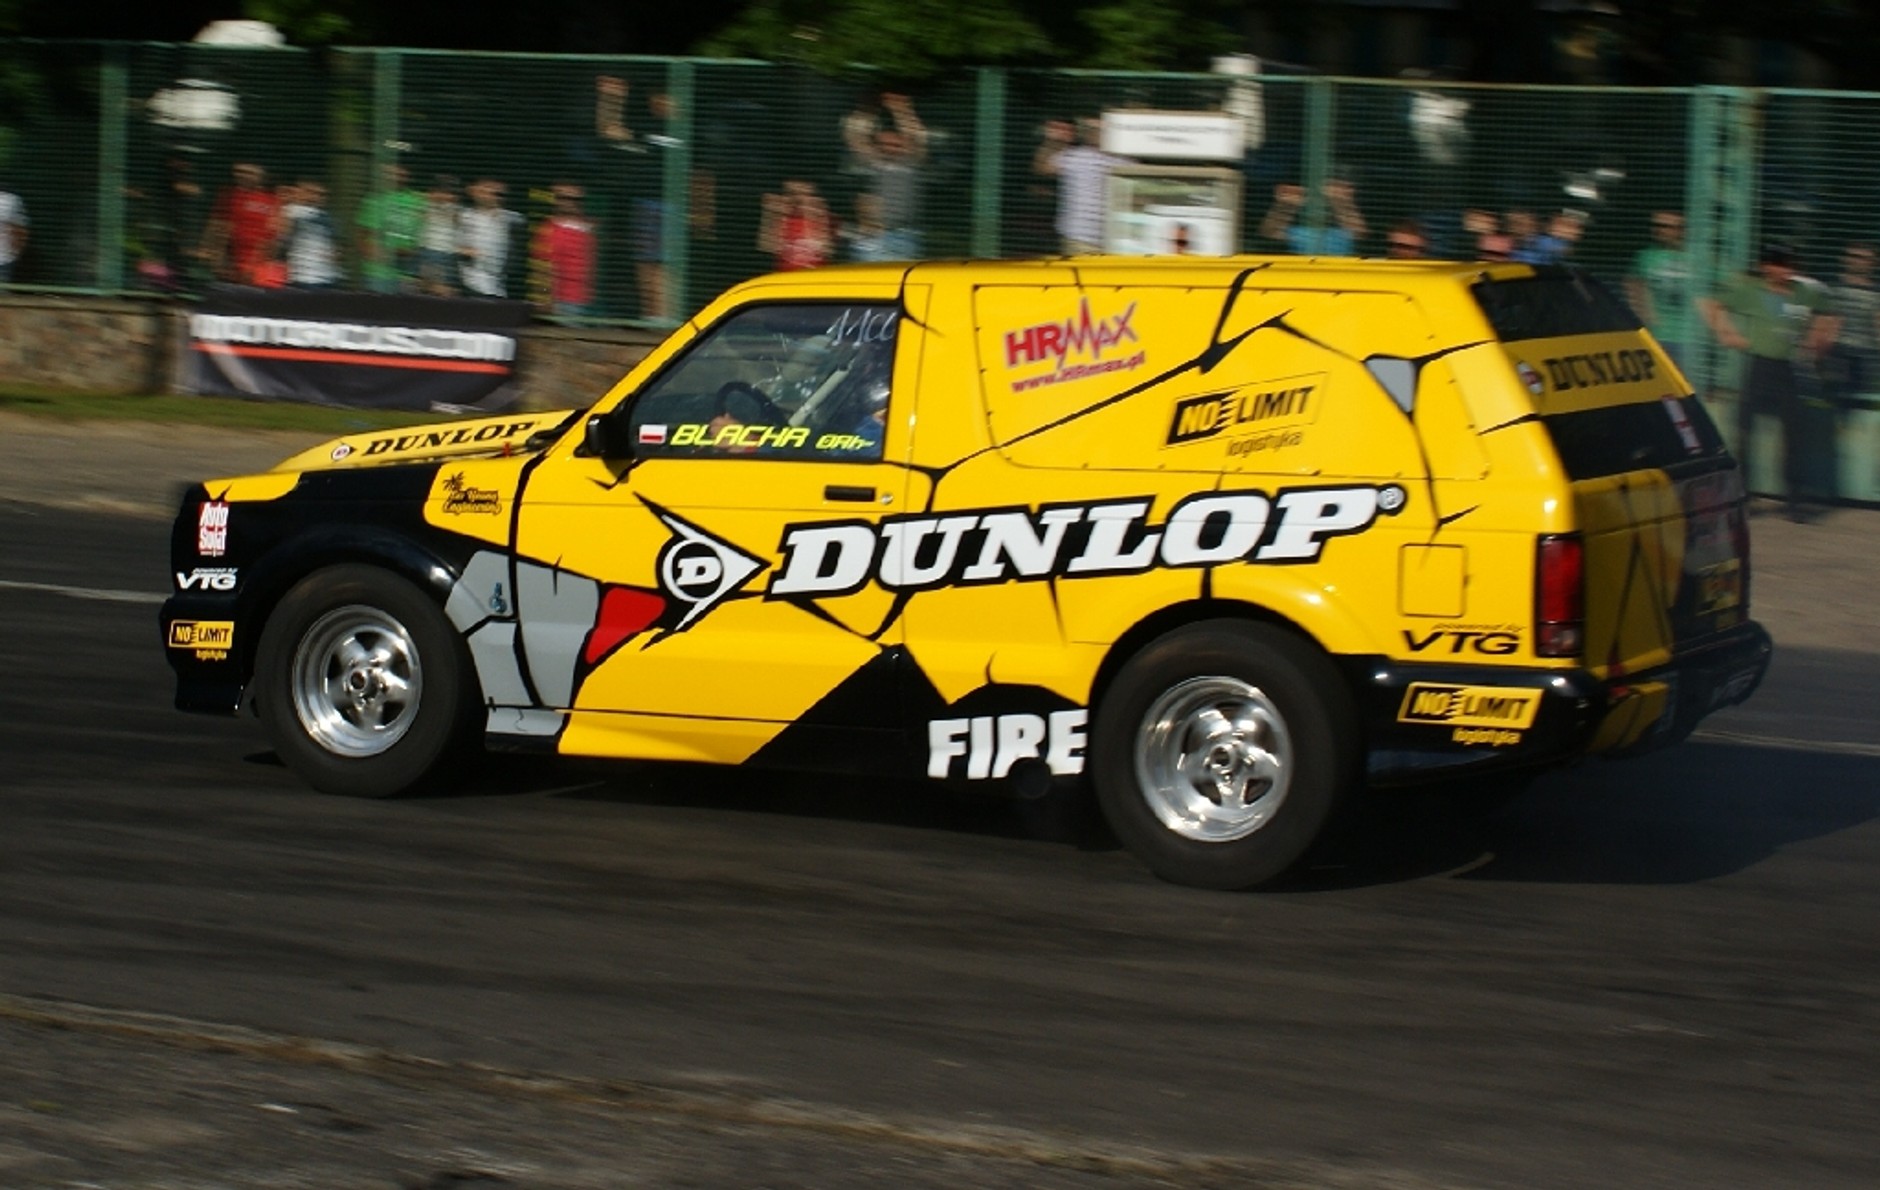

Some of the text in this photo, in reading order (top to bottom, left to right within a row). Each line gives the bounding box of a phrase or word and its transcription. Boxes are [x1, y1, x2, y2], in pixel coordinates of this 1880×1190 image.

[1542, 349, 1655, 391] DUNLOP
[1176, 386, 1315, 437] NO LIMIT
[361, 420, 536, 456] DUNLOP
[670, 424, 811, 448] BLACHA
[769, 486, 1379, 596] DUNLOP
[176, 572, 237, 590] VTG
[176, 626, 230, 642] NO LIMIT
[1401, 629, 1520, 655] VTG
[1412, 691, 1530, 719] NO LIMIT
[927, 708, 1089, 780] FIRE
